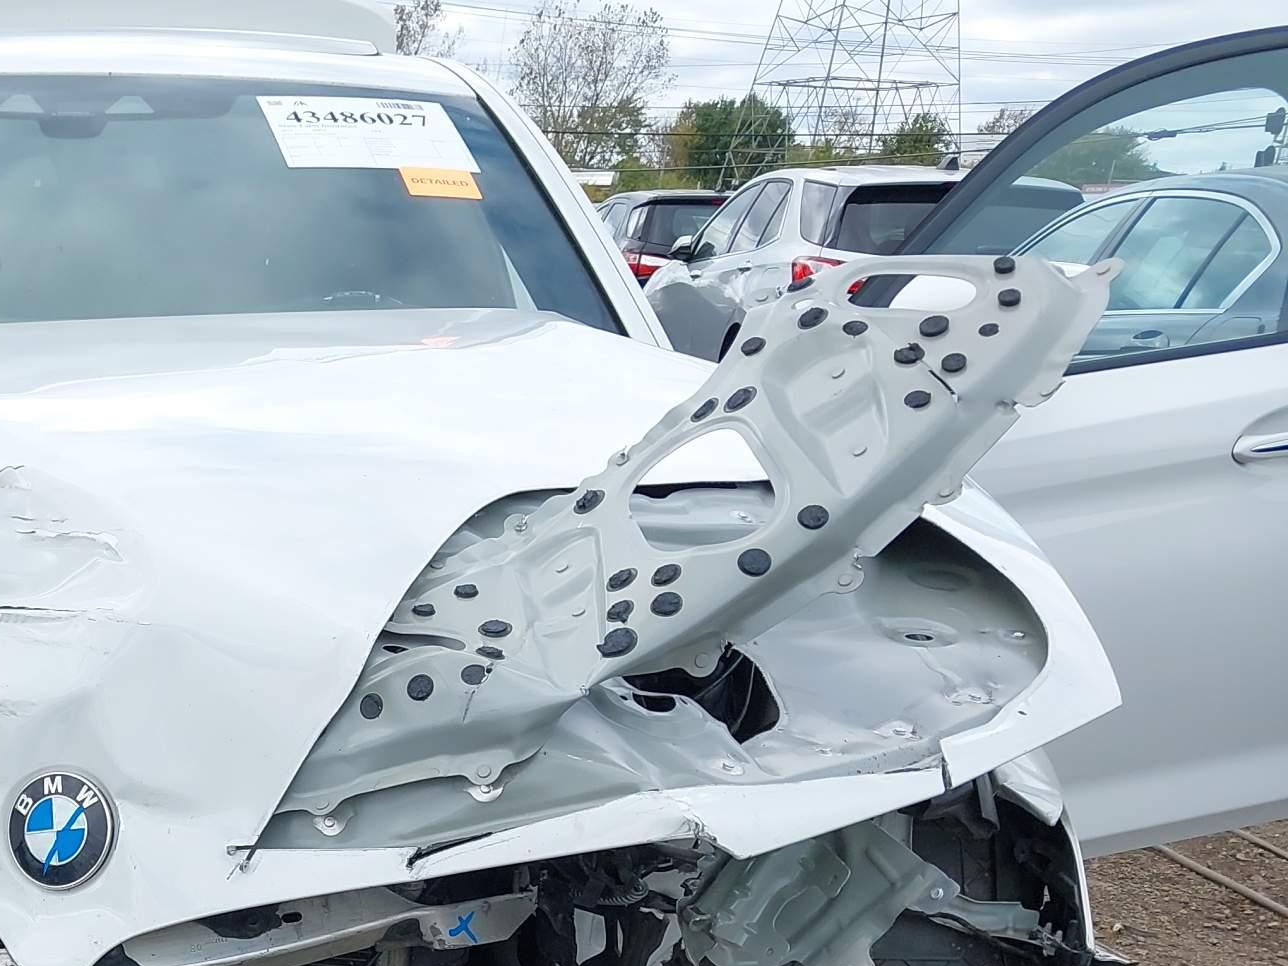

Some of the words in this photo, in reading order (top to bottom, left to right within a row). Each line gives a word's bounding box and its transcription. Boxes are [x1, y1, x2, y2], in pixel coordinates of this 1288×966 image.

[286, 110, 427, 127] 43486027
[410, 177, 470, 188] DETAILED
[14, 775, 99, 817] BMW
